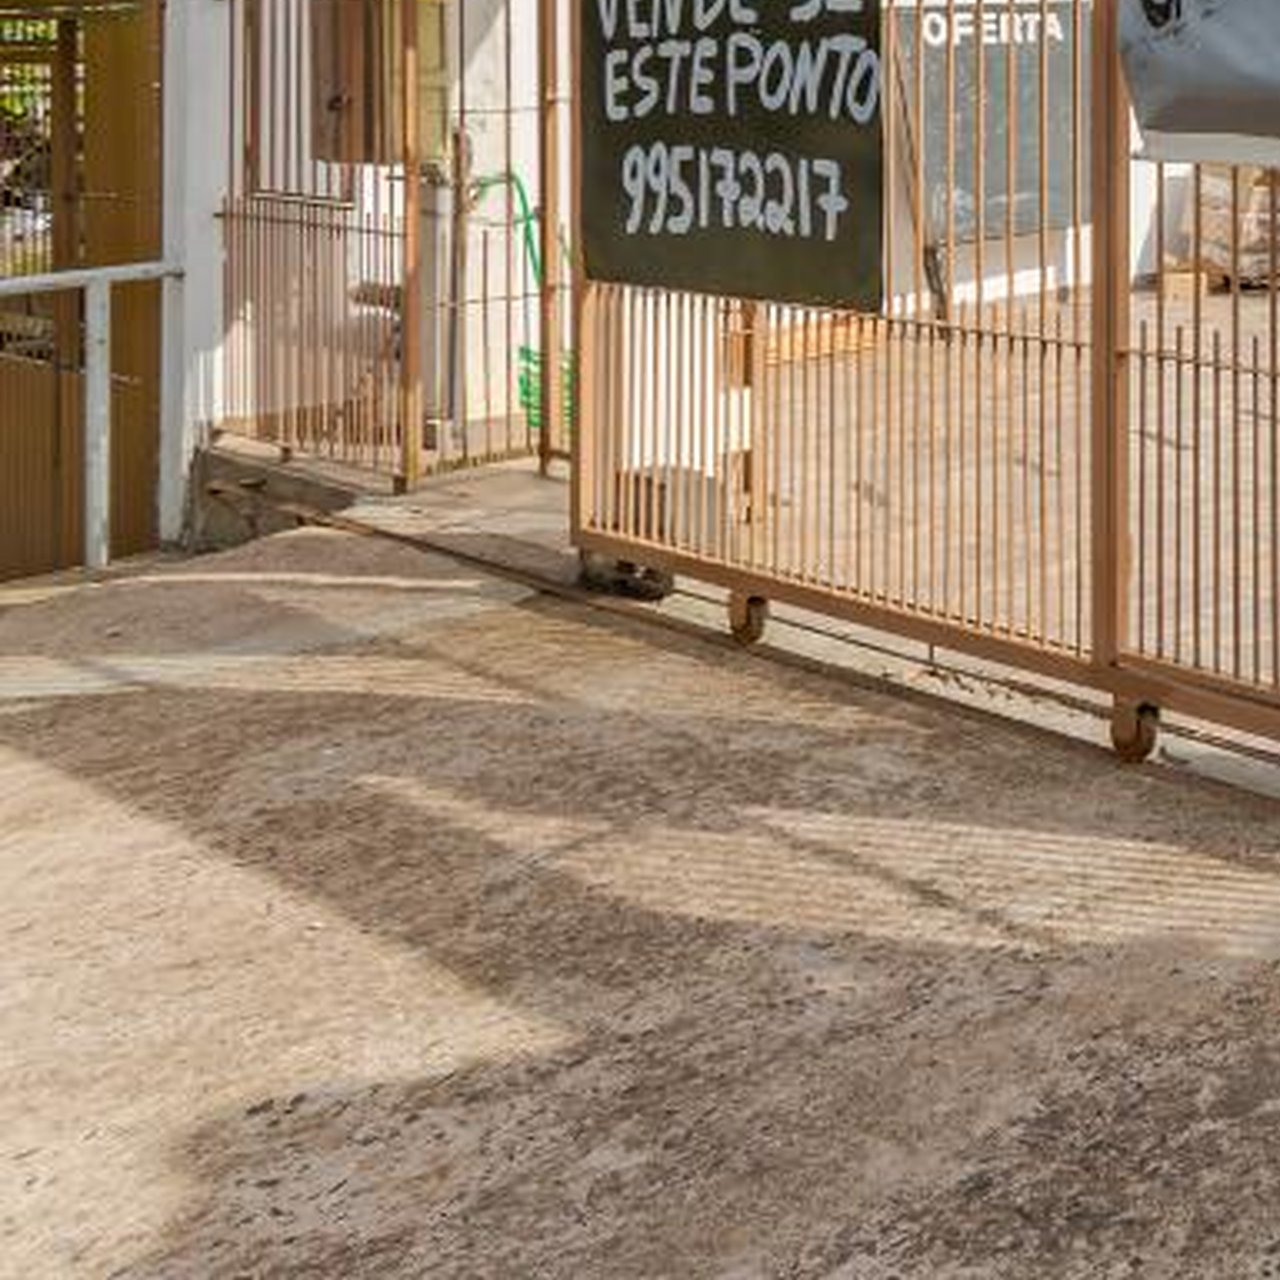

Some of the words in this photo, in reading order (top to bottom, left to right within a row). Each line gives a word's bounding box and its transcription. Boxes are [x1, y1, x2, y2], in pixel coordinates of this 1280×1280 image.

[923, 11, 1064, 48] OFERTA
[605, 37, 718, 121] ESTE
[727, 32, 881, 123] PONTO
[622, 140, 849, 242] 995172217
